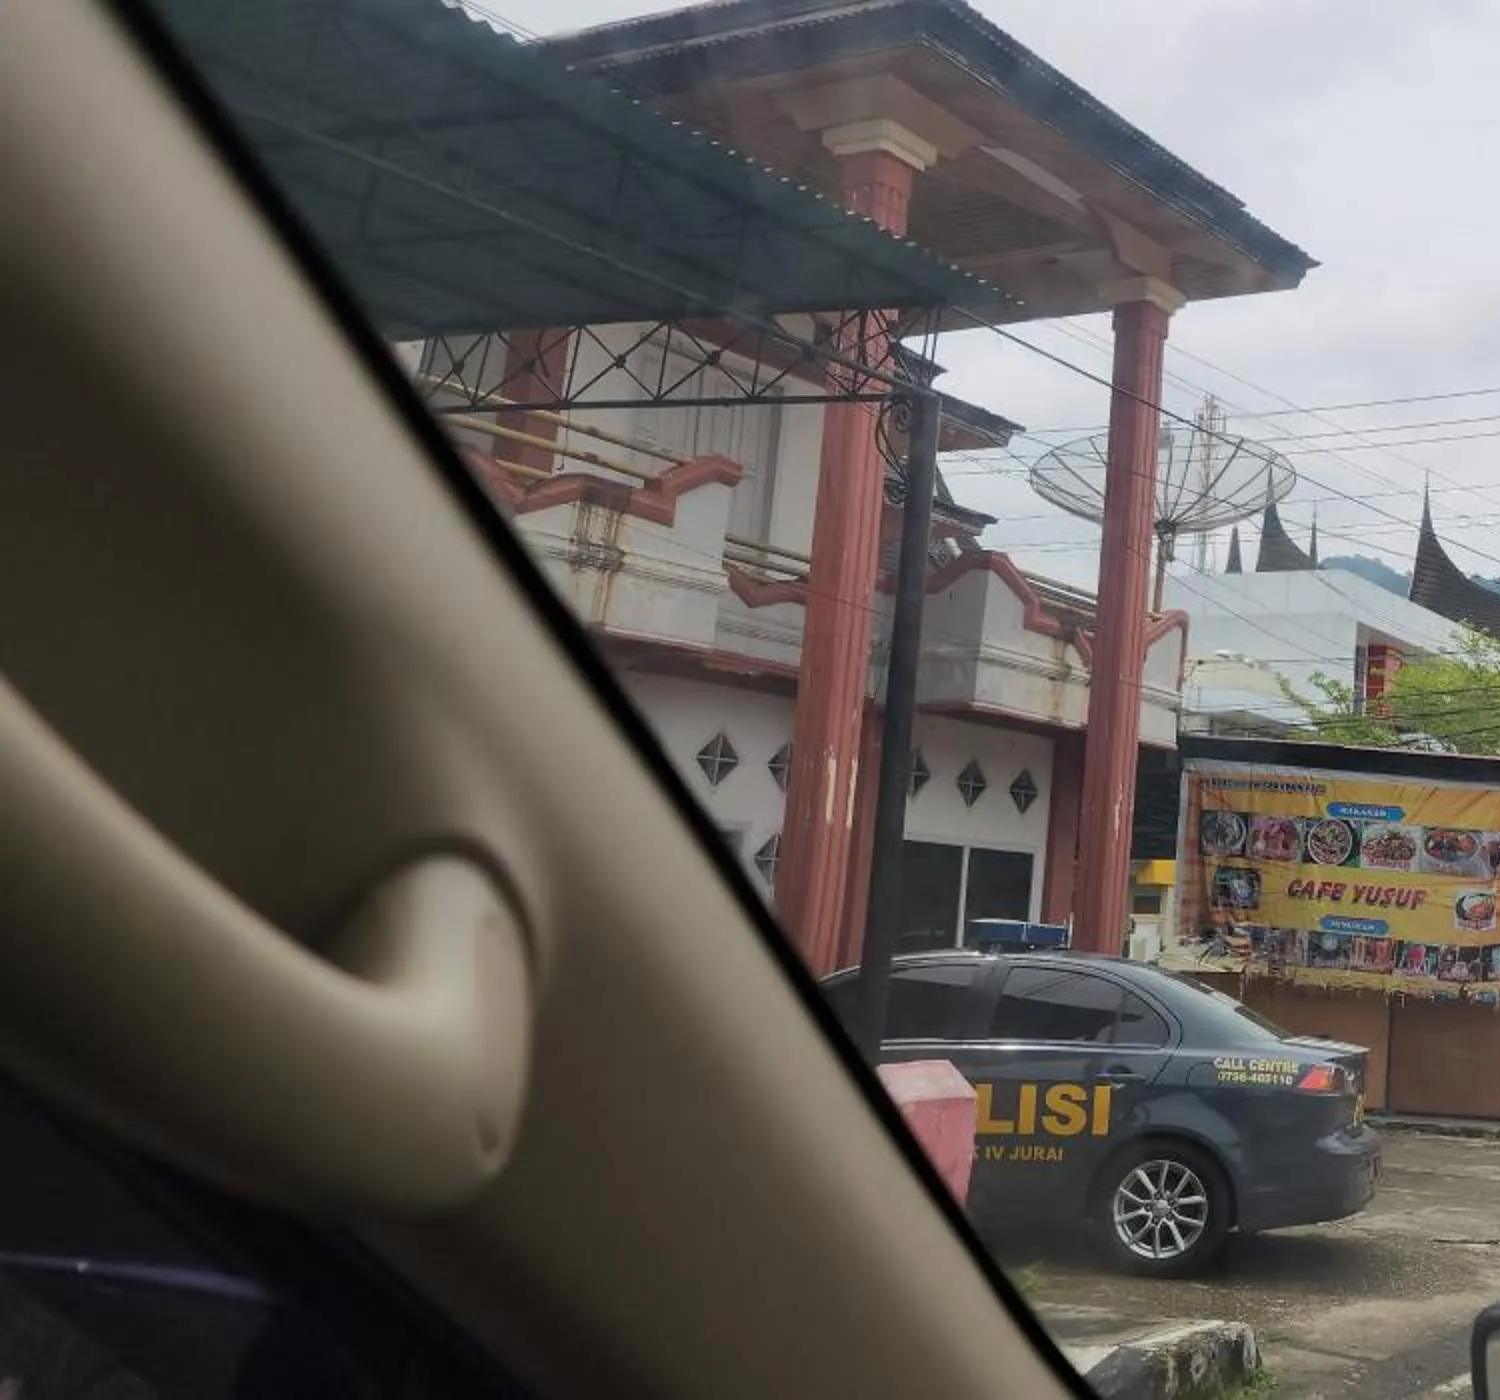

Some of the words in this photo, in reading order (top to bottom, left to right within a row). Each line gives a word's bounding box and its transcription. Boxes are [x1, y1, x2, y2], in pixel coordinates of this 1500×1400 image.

[1287, 879, 1347, 901] CAFE
[1352, 884, 1427, 910] YUSUF
[1213, 1057, 1246, 1071] CALL
[1249, 1059, 1299, 1074] CENTRE
[975, 1082, 1112, 1136] LISI
[985, 1145, 1004, 1160] IV
[1010, 1145, 1064, 1161] JURAI
